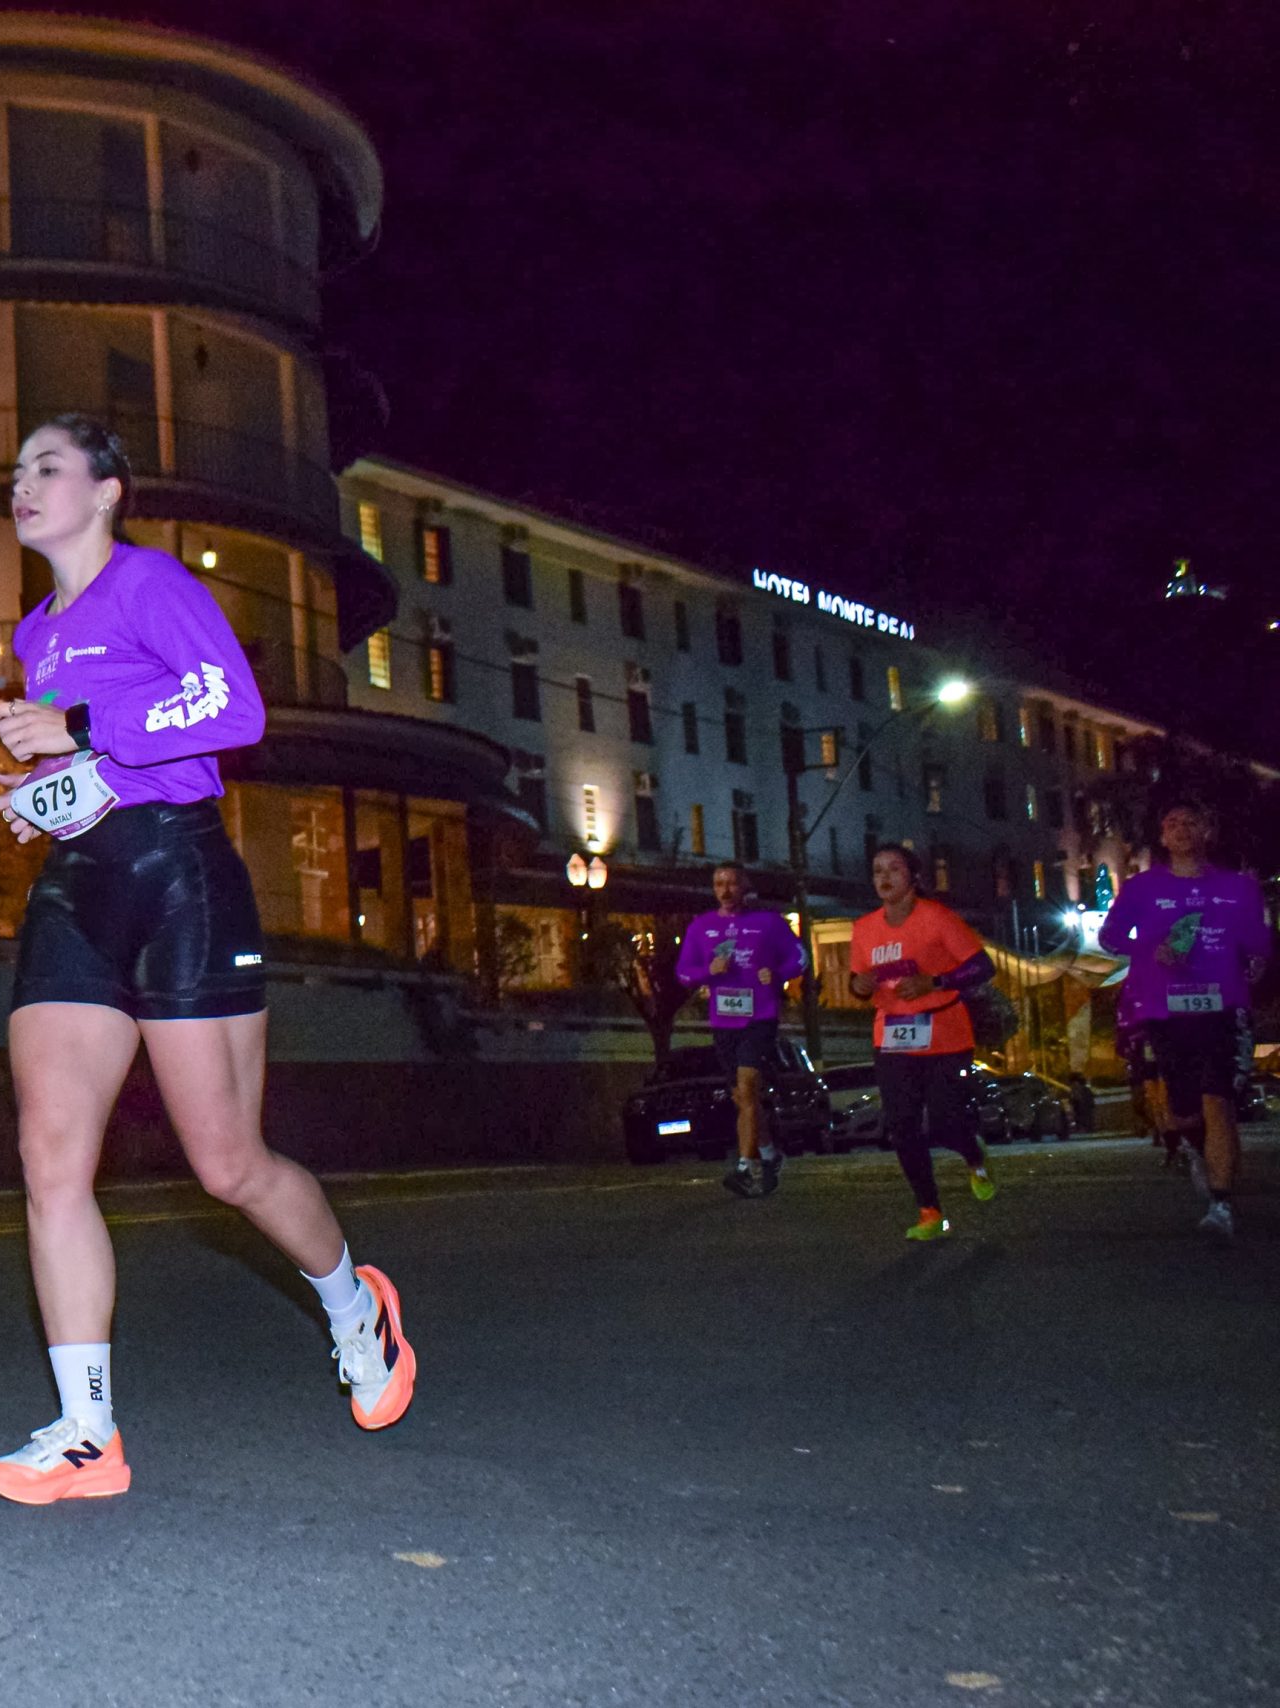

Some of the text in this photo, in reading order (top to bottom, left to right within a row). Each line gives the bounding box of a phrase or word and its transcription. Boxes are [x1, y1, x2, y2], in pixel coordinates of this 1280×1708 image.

[753, 568, 810, 604] HOTEL
[817, 590, 875, 627] MONTE
[32, 775, 77, 817] 679
[49, 812, 73, 826] NATALY
[723, 998, 743, 1009] 464
[1181, 998, 1213, 1011] 193
[891, 1027, 917, 1040] 421
